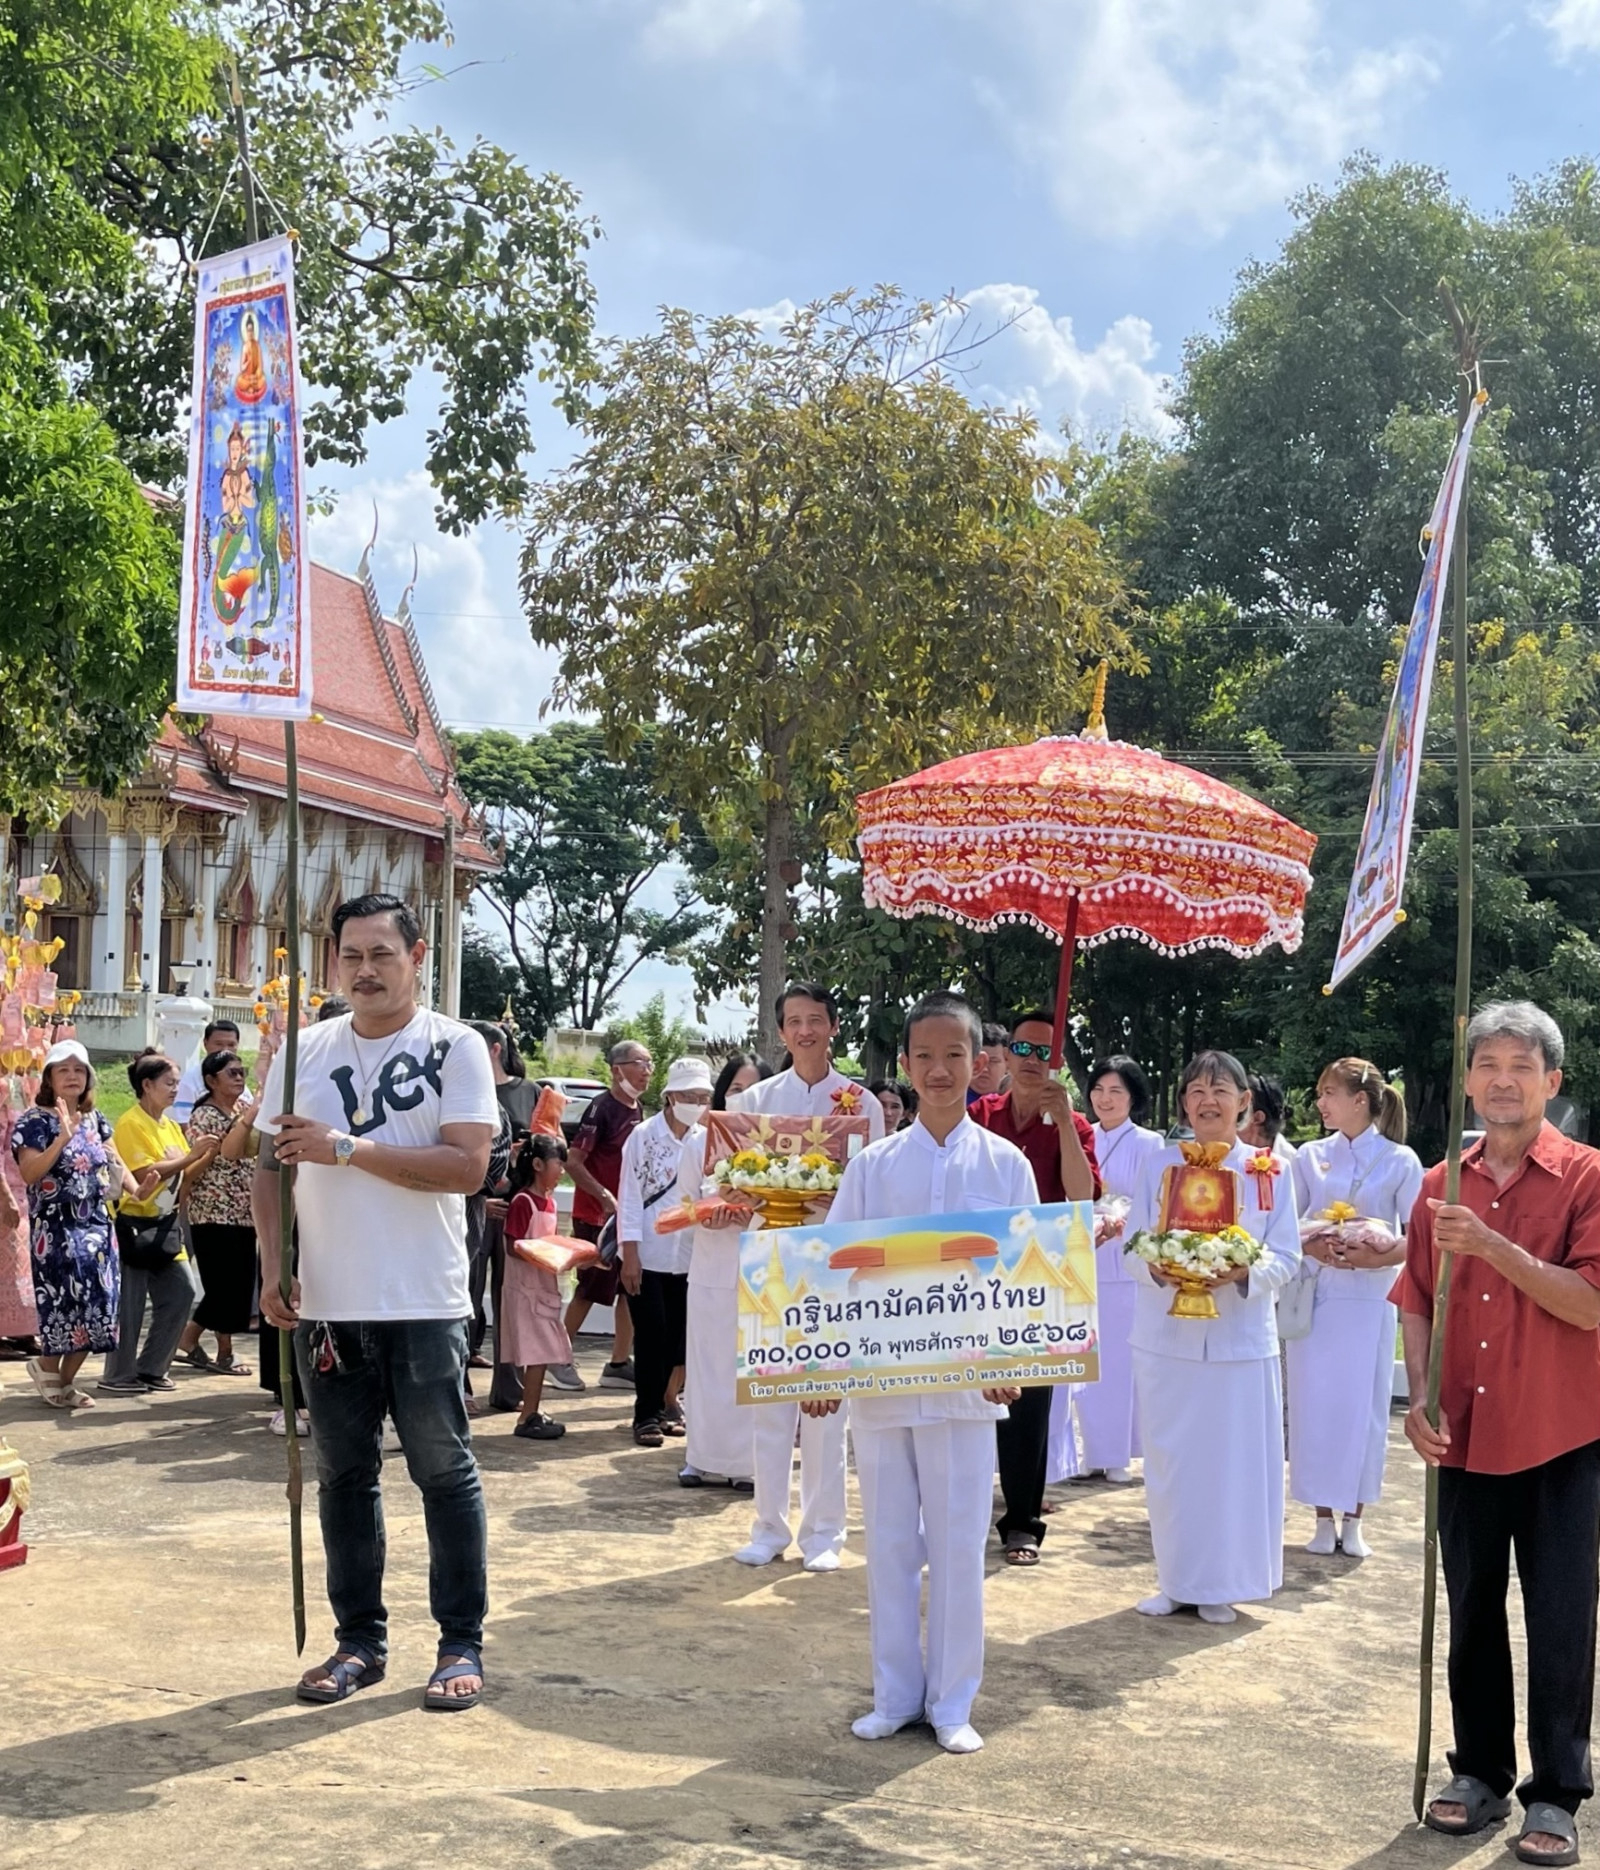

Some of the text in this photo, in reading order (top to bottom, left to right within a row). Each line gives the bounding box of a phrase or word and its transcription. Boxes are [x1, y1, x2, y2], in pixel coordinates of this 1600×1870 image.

[784, 1275, 1047, 1333] กฐินสามัคคีทั่วไทย
[748, 1320, 1087, 1366] ๓๐,๐๐๐ วัด พุทธศักราช ๒๕๖๘
[750, 1383, 773, 1396] โดย
[777, 1374, 874, 1393] คณะศิษยานุศิษย์
[878, 1373, 938, 1391] บูชาธรรม
[966, 1366, 976, 1381] ปี
